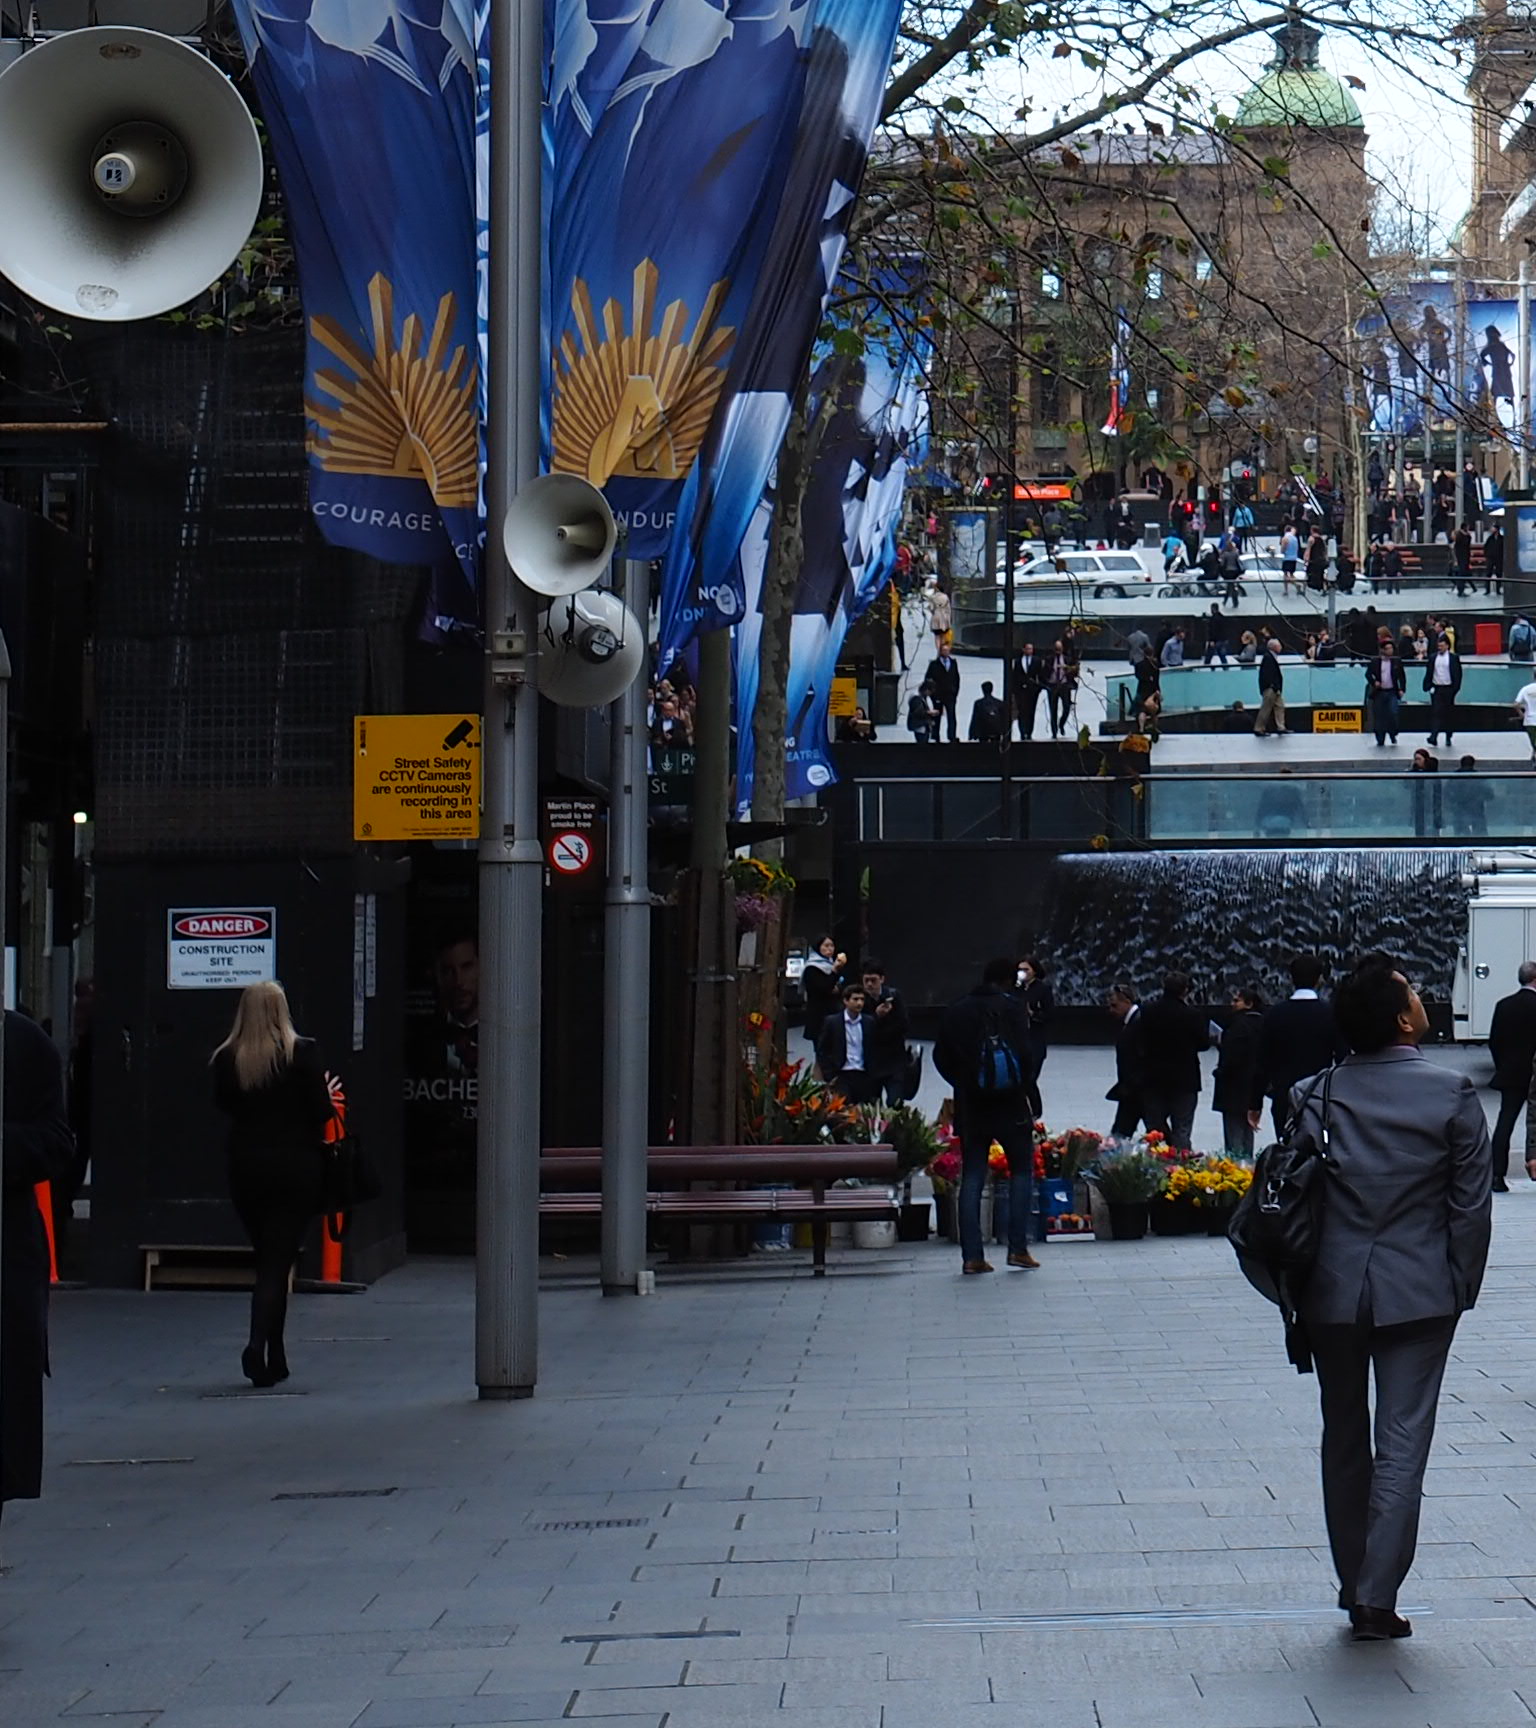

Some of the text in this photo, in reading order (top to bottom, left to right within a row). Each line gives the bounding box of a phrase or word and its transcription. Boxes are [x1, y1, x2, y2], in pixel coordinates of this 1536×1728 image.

[311, 501, 433, 532] COURAGE
[1318, 711, 1357, 722] CAUTION
[394, 757, 472, 770] Street Safety
[379, 770, 472, 782] CCTV Cameras
[372, 782, 472, 796] are continuously
[651, 778, 668, 794] St
[400, 795, 473, 809] recording in
[420, 808, 472, 820] this area
[188, 919, 255, 933] DANGER
[178, 944, 265, 955] CONSTRUCTION
[209, 957, 234, 966] SITE
